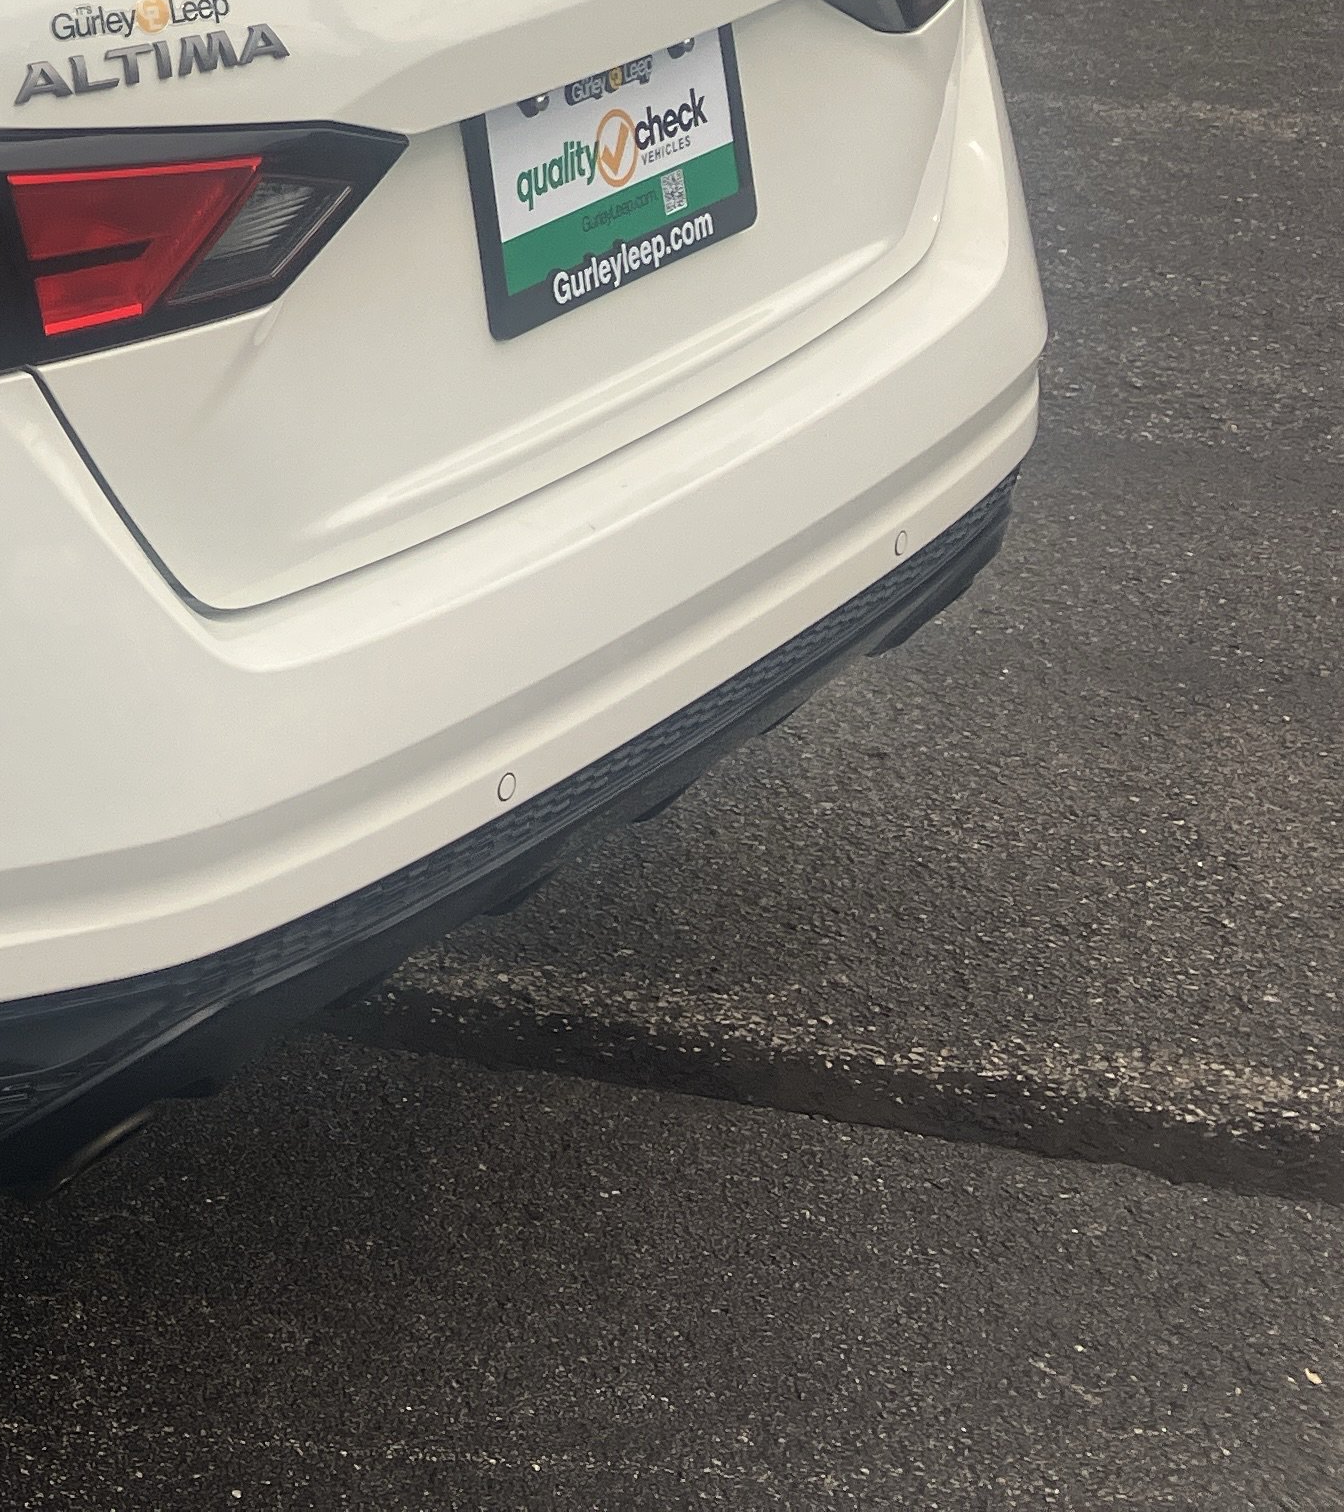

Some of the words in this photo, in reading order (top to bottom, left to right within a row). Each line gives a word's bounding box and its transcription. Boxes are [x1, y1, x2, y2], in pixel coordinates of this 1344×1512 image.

[13, 22, 291, 107] ALTIMA
[51, 5, 136, 40] Gurley
[516, 140, 600, 212] quality
[635, 88, 709, 150] check
[641, 135, 692, 166] VEHICLES
[552, 211, 714, 306] Gurleyleep.com
